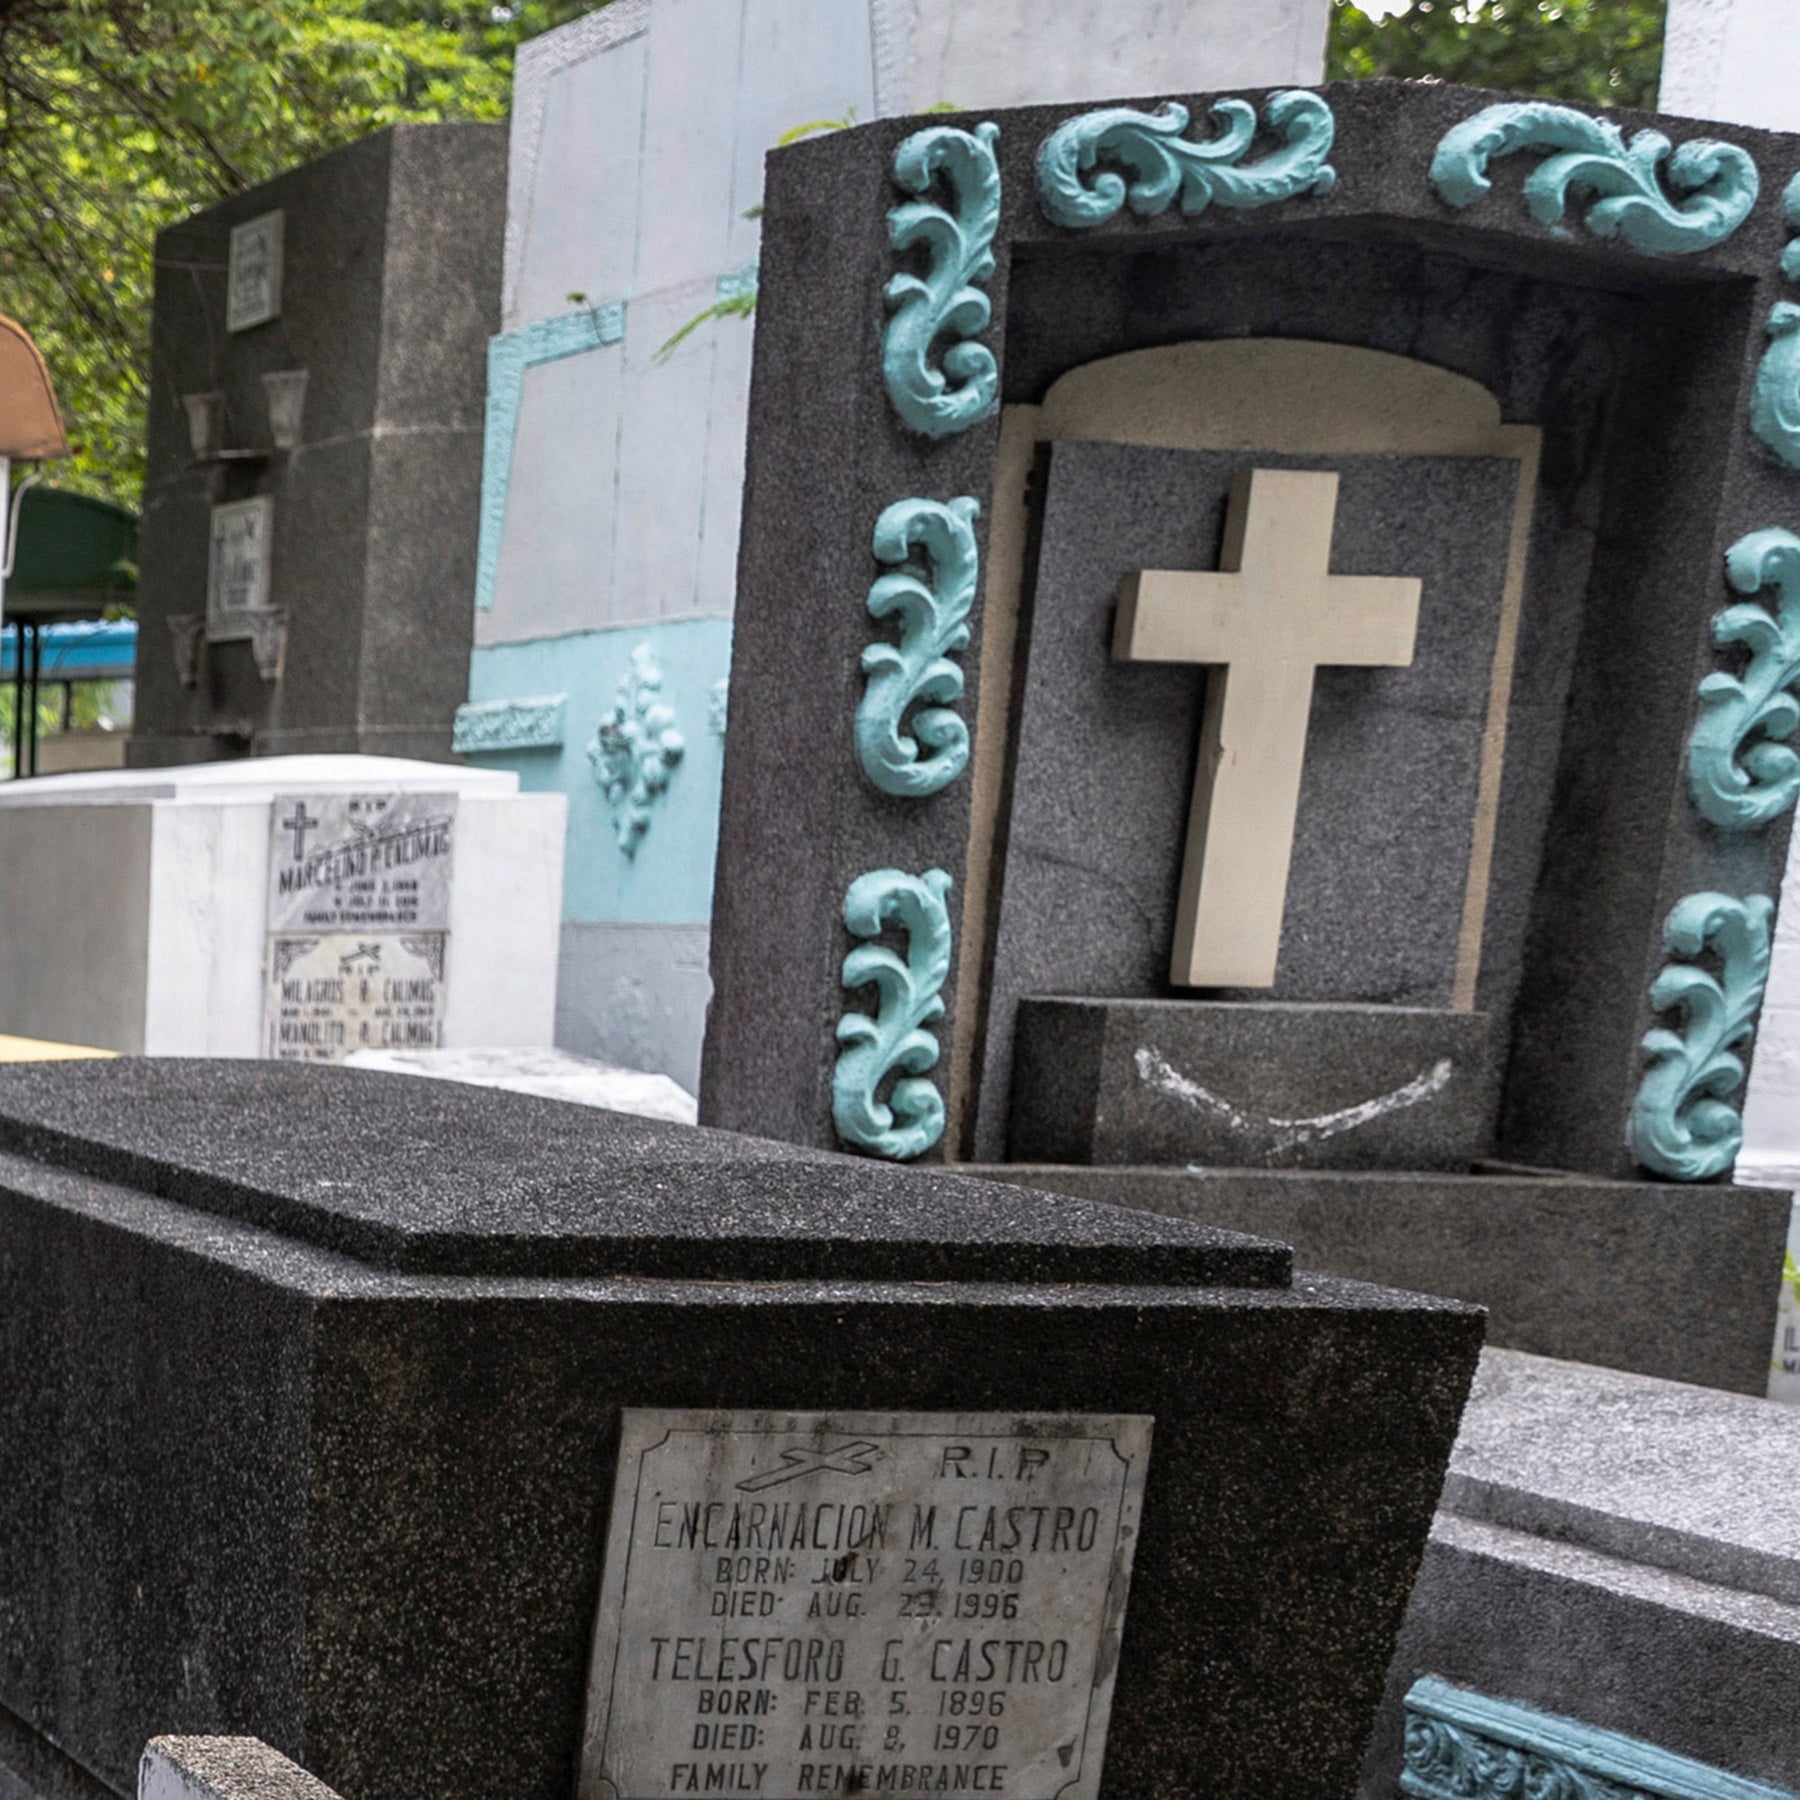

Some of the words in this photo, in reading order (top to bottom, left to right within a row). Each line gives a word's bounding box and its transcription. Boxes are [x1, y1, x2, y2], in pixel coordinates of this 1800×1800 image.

[654, 1502, 890, 1551] ENCARNACION
[911, 1505, 942, 1551] M.
[956, 1506, 1100, 1552] CASTRO
[716, 1557, 795, 1584] BORN:
[811, 1557, 880, 1586] JULY
[959, 1558, 1024, 1585] 1900
[807, 1592, 867, 1618] AUG.
[954, 1592, 1020, 1619] 1996
[649, 1638, 844, 1684] TELESFORO
[881, 1639, 906, 1683] G.
[930, 1639, 1070, 1684] CASTRO
[697, 1689, 779, 1716] BORN:
[939, 1690, 1006, 1718] 1896
[692, 1723, 767, 1751] DIED:
[798, 1724, 862, 1752] AUG.
[934, 1724, 1000, 1752] 1970
[669, 1763, 770, 1793] FAMILY
[797, 1764, 1009, 1793] REMEMBRANCE
